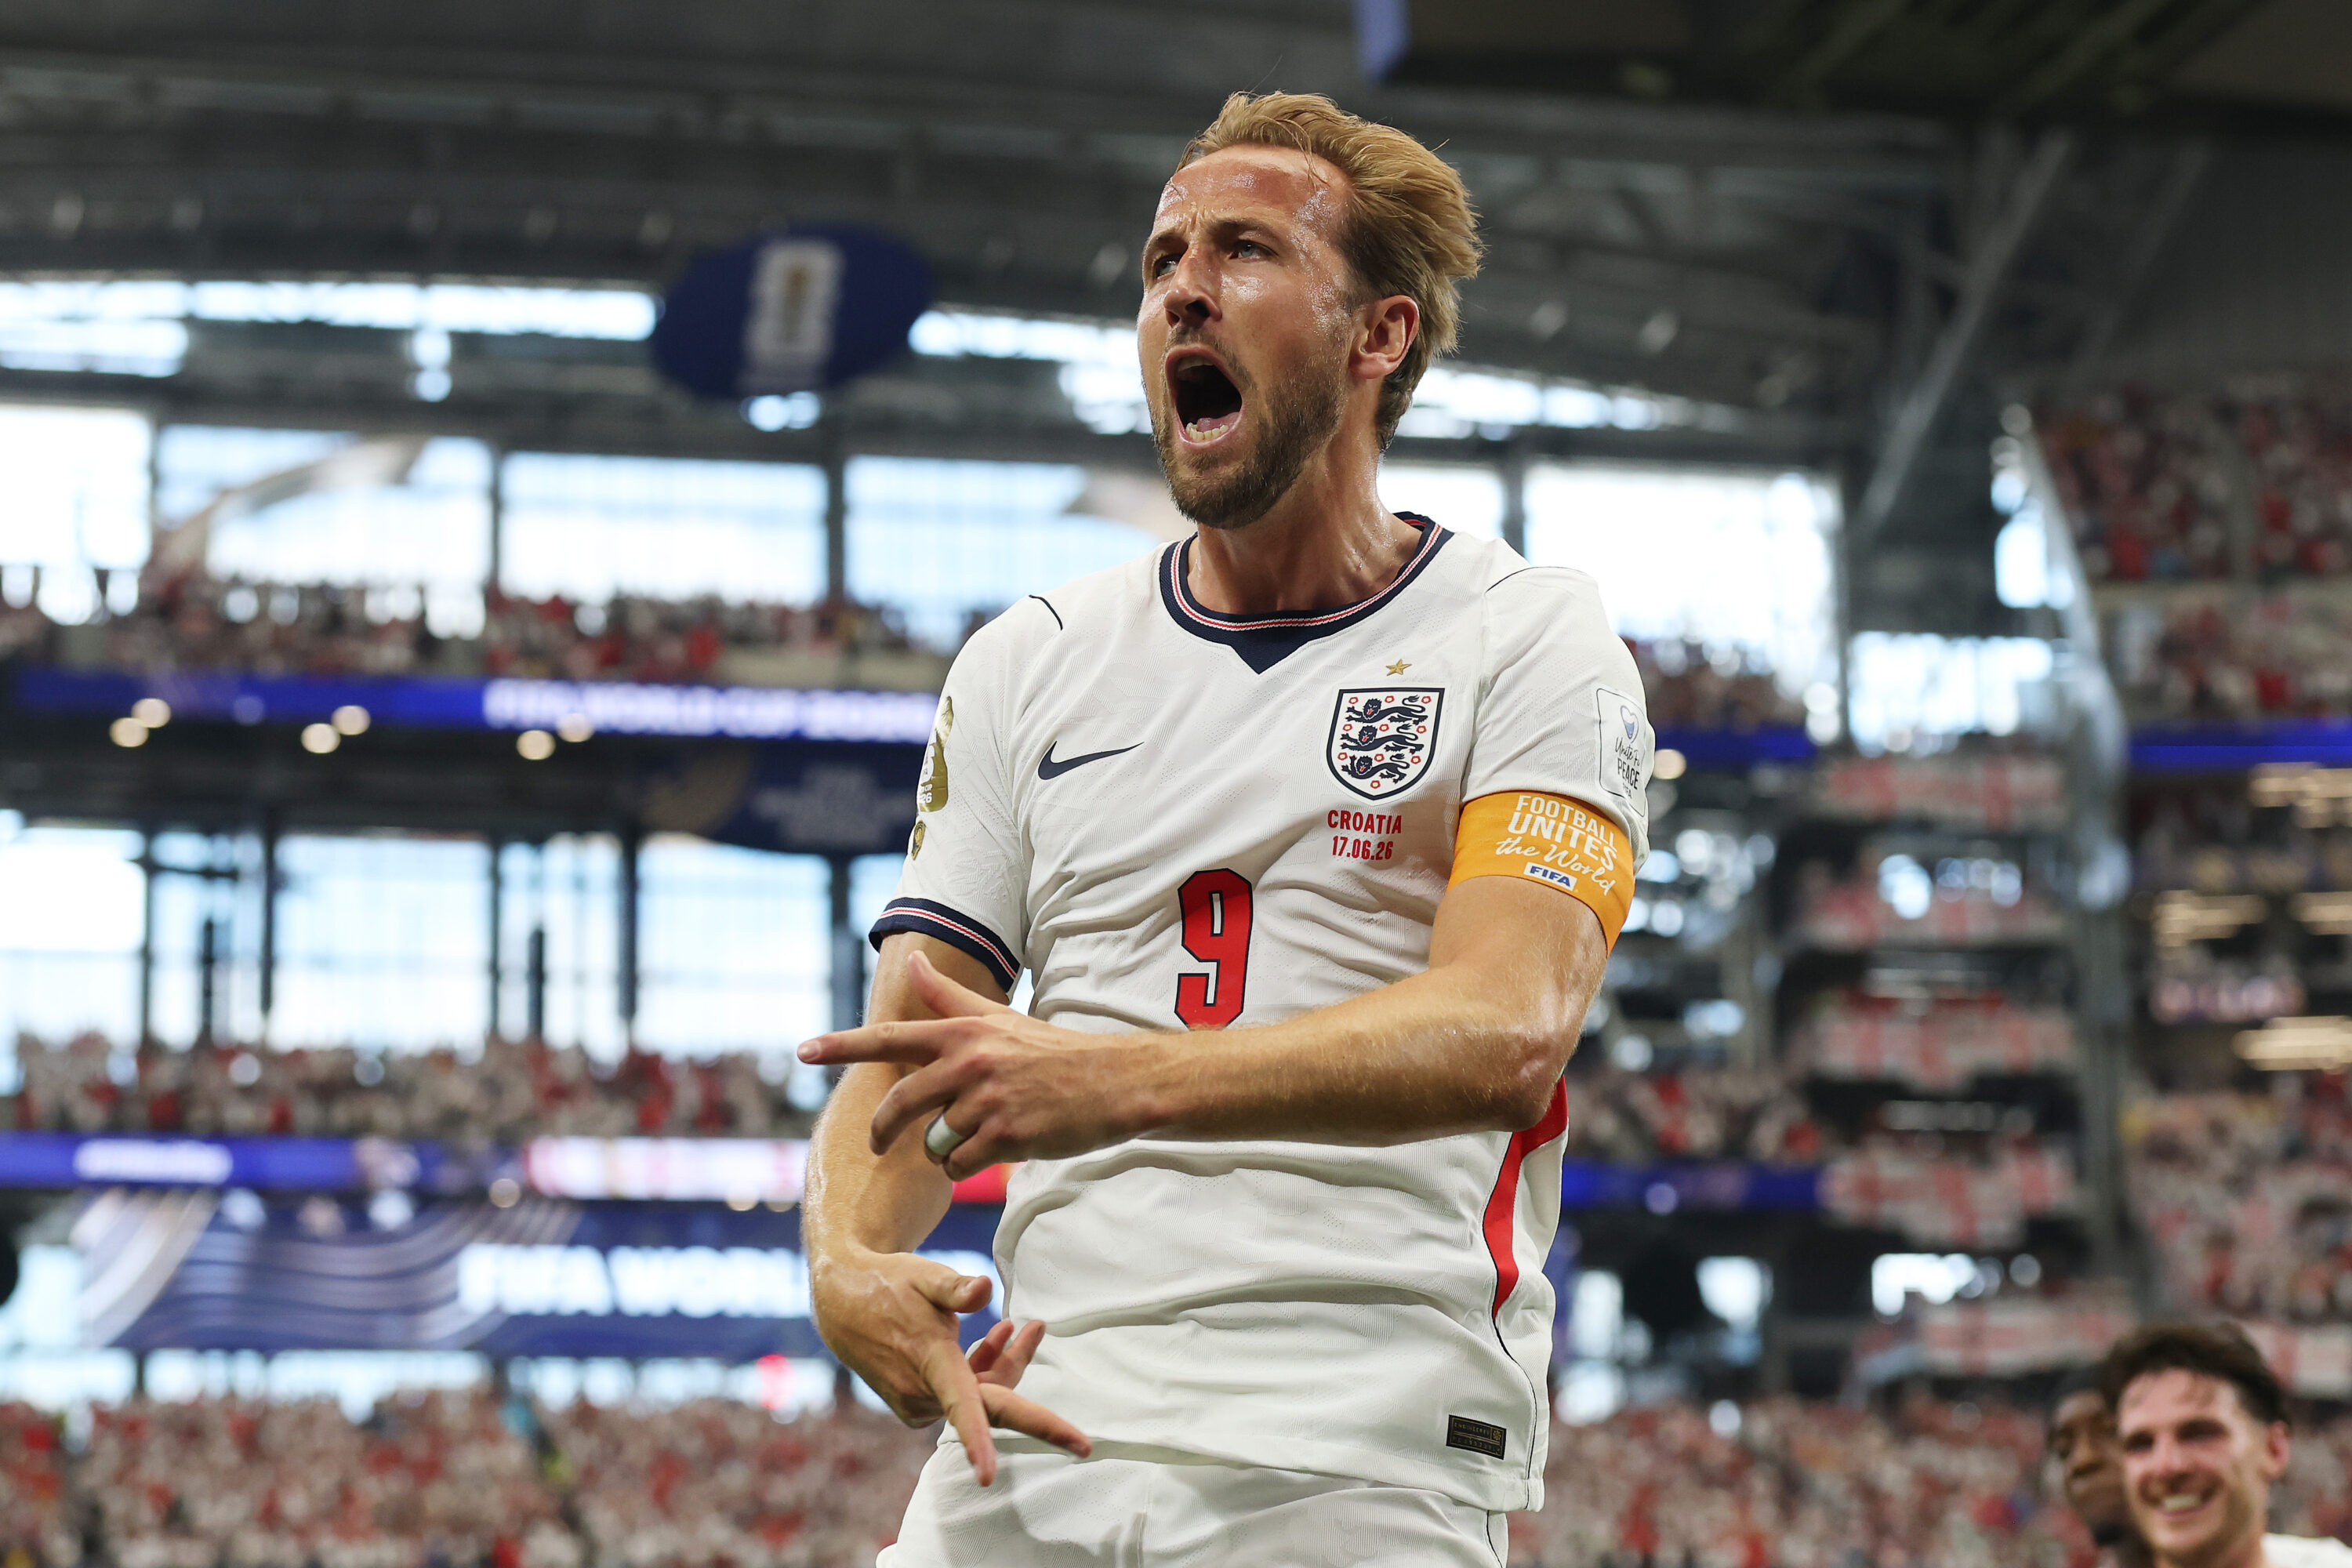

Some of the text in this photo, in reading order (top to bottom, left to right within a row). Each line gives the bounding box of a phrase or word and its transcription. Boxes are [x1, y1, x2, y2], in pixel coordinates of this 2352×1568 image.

[1615, 737, 1633, 760] Unite
[1617, 758, 1639, 790] PEACE
[1327, 810, 1402, 835] CROATIA
[1515, 794, 1618, 853] FOOTBALL
[1332, 836, 1394, 860] 17.06.26
[1508, 811, 1617, 872] UNITES
[1495, 836, 1617, 896] the World
[1530, 865, 1571, 887] FIFA
[1174, 867, 1254, 1032] 9
